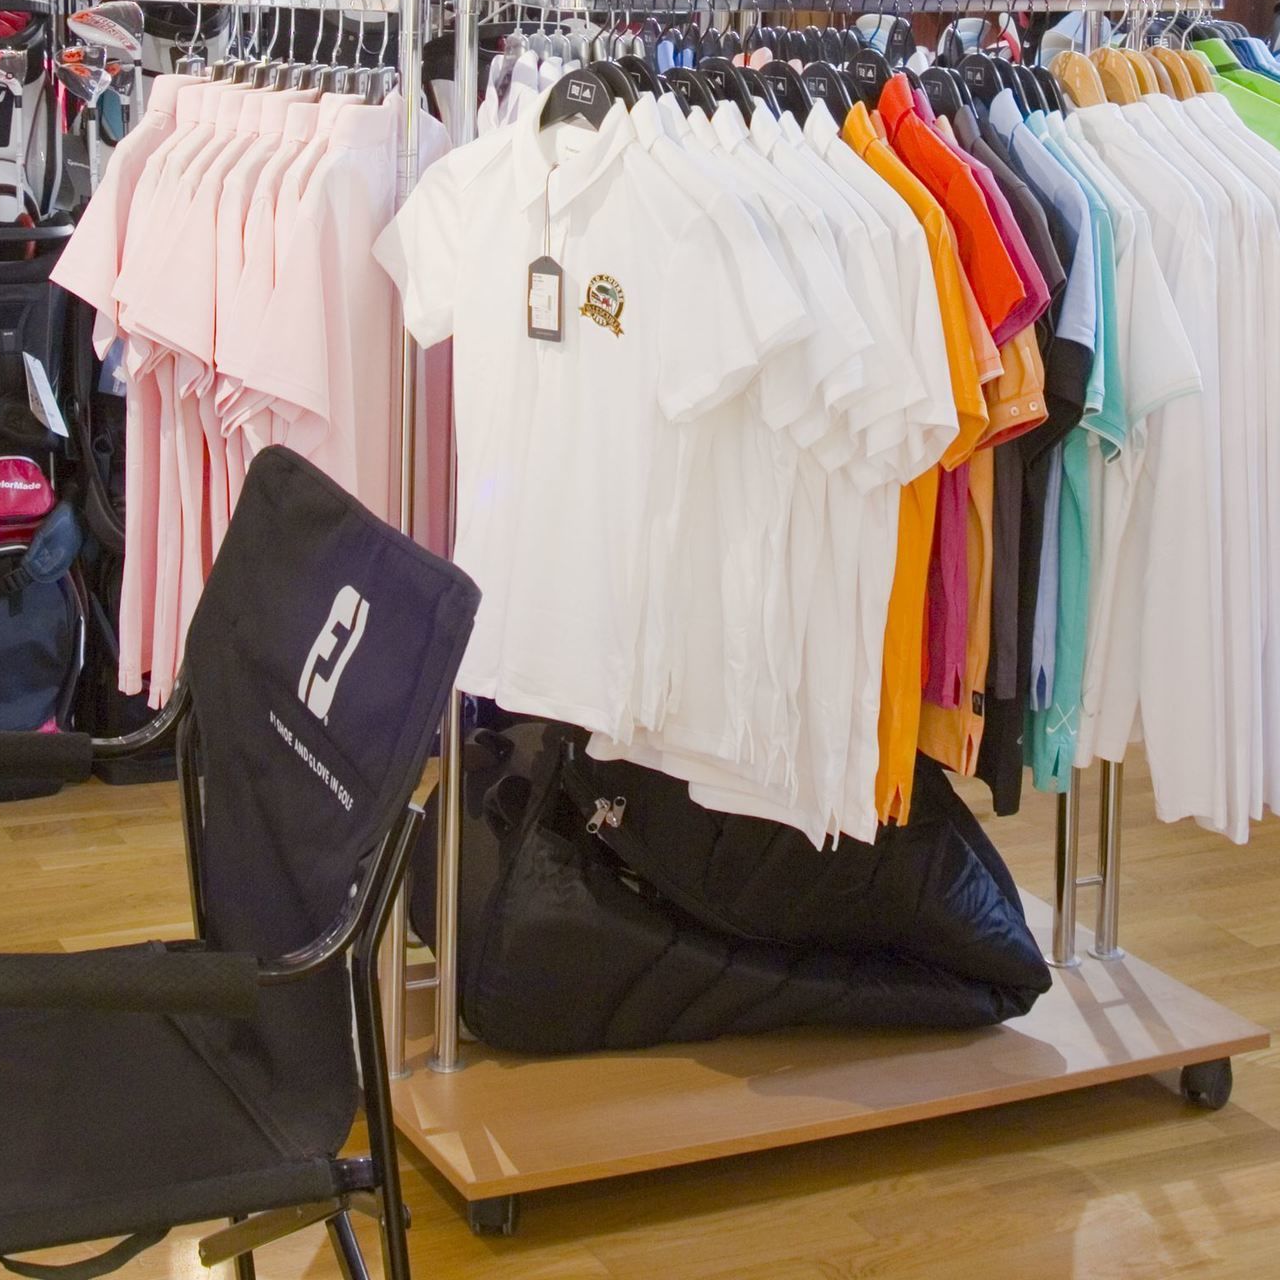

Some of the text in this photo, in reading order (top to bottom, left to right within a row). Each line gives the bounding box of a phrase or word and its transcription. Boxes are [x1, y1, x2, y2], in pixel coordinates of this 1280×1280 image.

[276, 719, 293, 746] SHOE
[294, 737, 308, 762] AND
[308, 754, 330, 785] GLOVE
[329, 775, 339, 794] IN
[338, 785, 354, 812] GOLF
